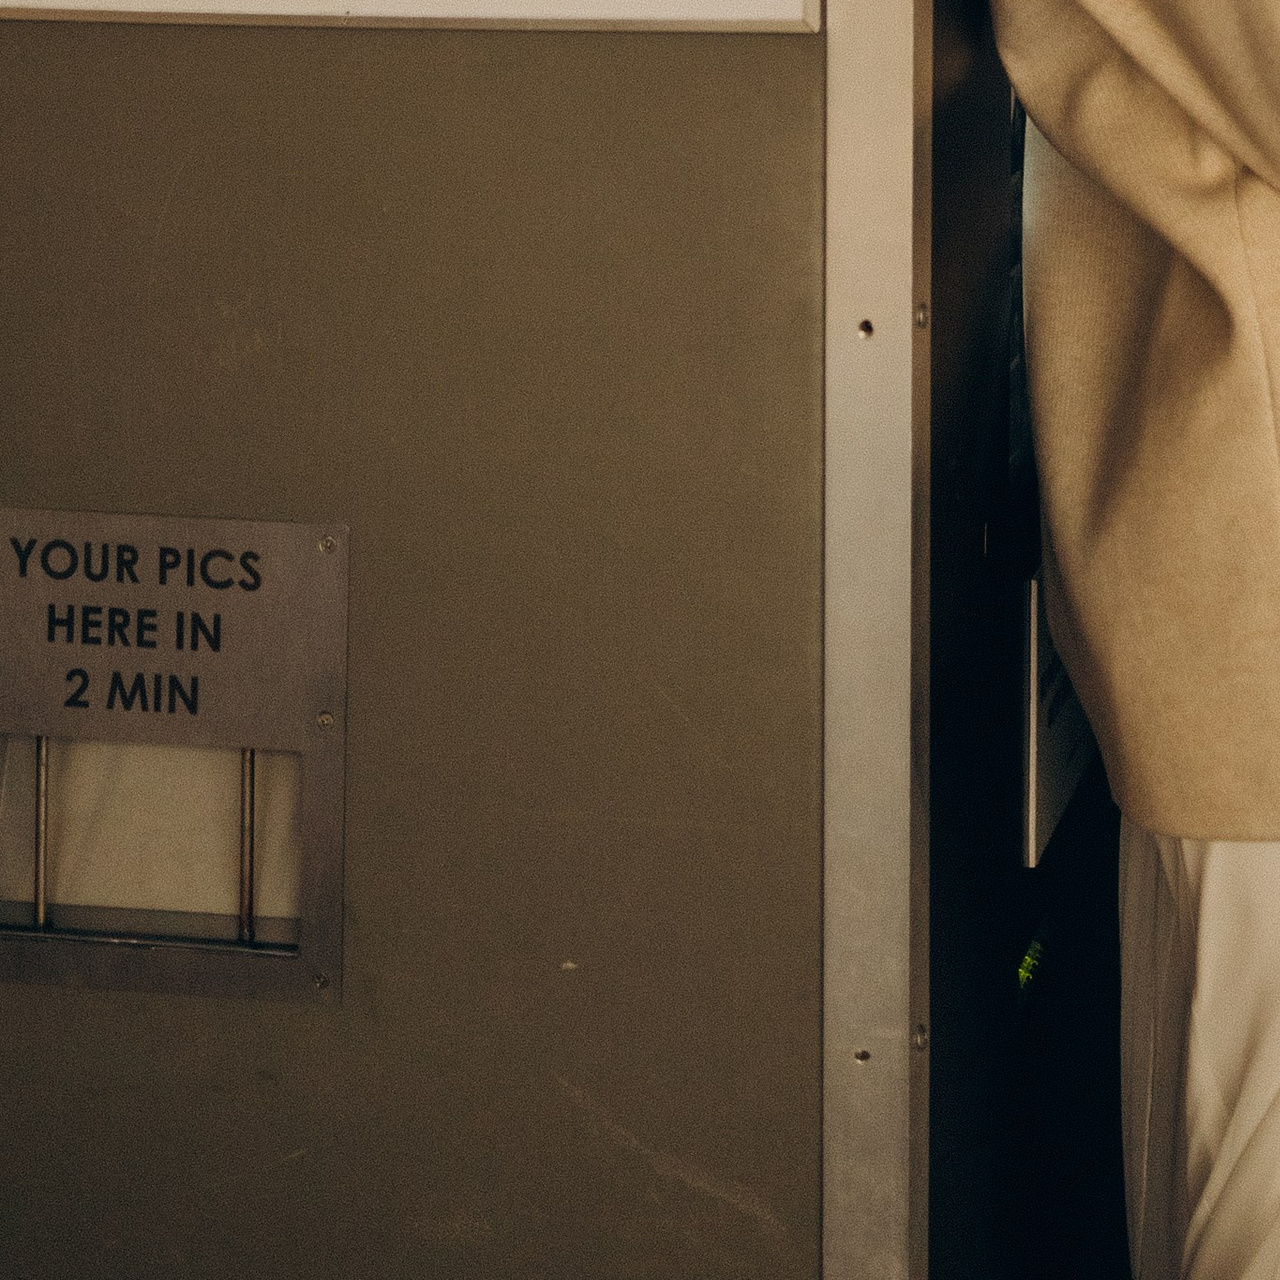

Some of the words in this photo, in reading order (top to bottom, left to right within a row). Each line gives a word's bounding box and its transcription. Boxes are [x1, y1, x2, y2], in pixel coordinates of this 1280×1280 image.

[10, 538, 140, 584] YOUR
[159, 546, 262, 591] PICS
[47, 604, 157, 648] HERE
[176, 611, 222, 653] IN
[64, 668, 90, 708] 2
[106, 671, 199, 715] MIN
